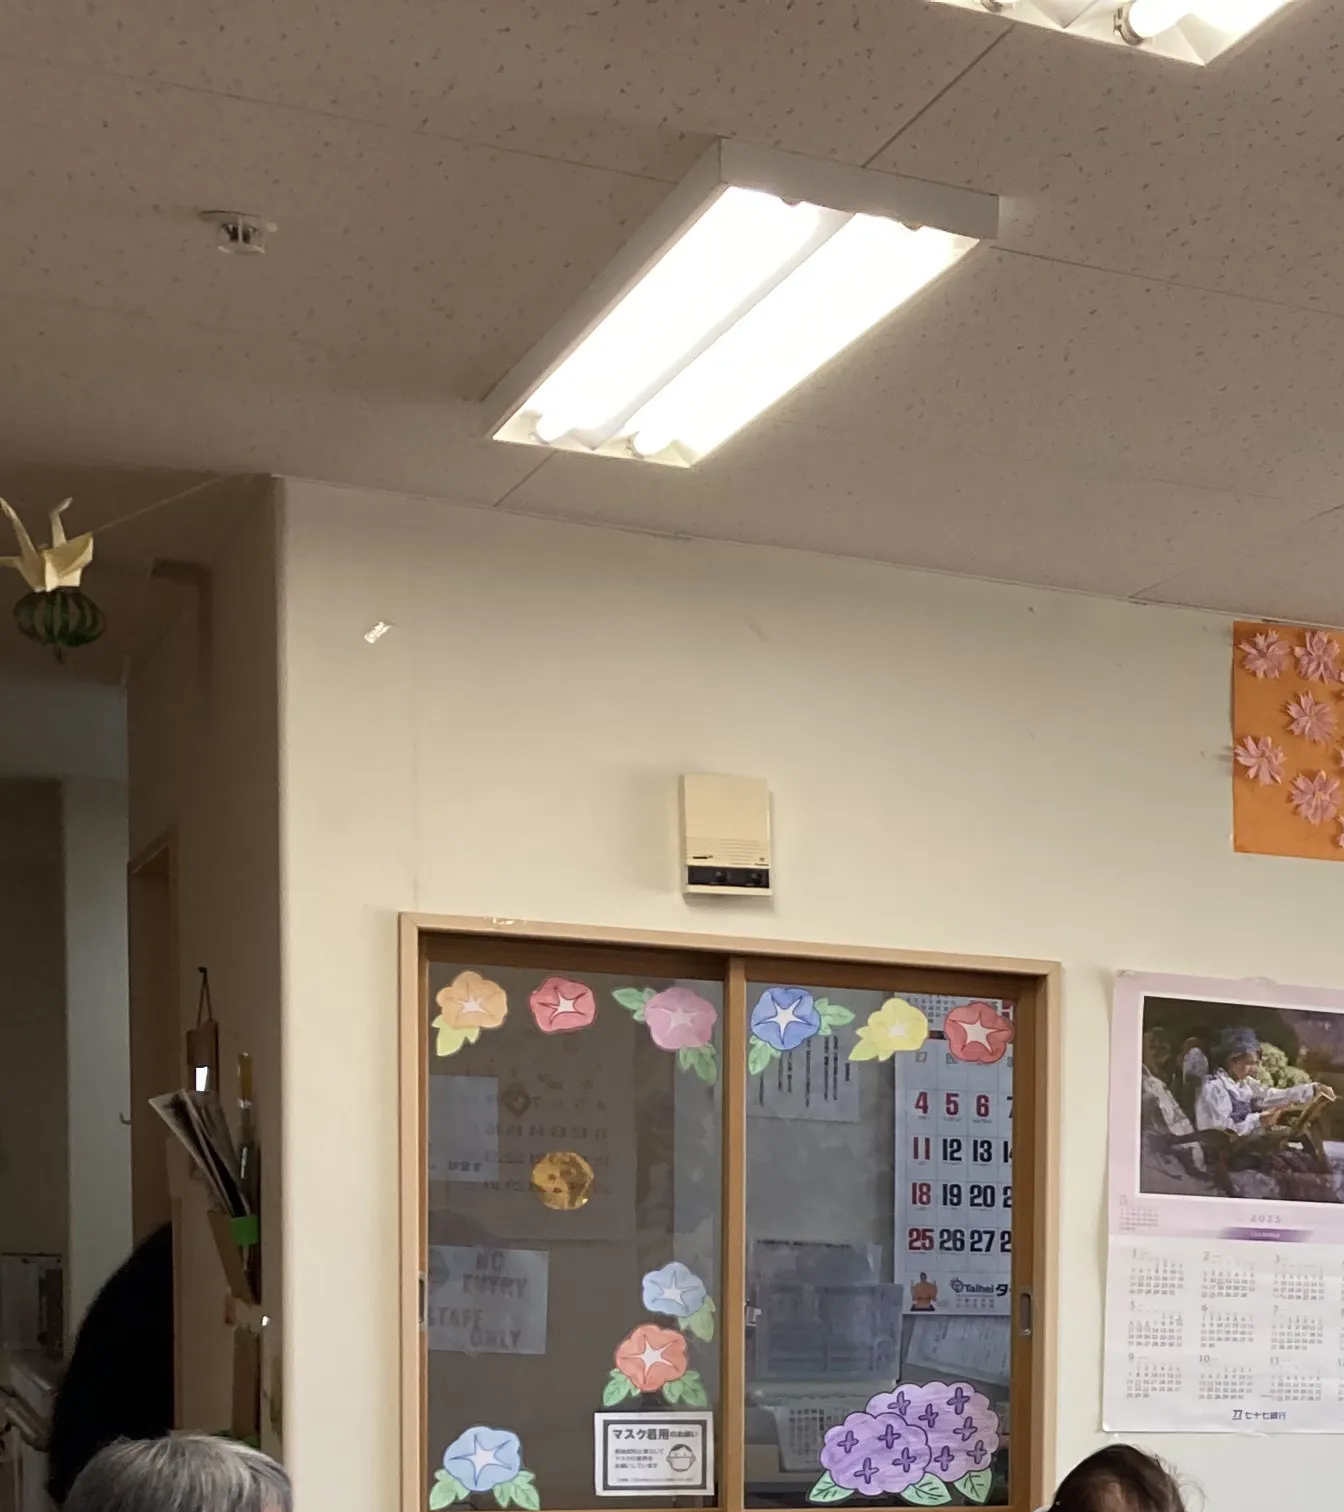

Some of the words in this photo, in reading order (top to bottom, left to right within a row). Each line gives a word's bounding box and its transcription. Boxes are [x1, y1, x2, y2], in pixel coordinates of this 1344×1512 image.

[915, 1091, 929, 1114] 4
[945, 1093, 959, 1115] 5
[976, 1094, 989, 1117] 6
[913, 1137, 930, 1160] 11
[942, 1138, 962, 1161] 12
[973, 1139, 992, 1162] 13
[1003, 1141, 1013, 1163] 1
[911, 1182, 931, 1205] 18
[942, 1183, 962, 1206] 19
[969, 1184, 995, 1208] 20
[1002, 1186, 1012, 1208] 2
[908, 1228, 935, 1251] 25
[939, 1228, 965, 1252] 26
[969, 1229, 996, 1253] 27
[1000, 1230, 1012, 1253] 2
